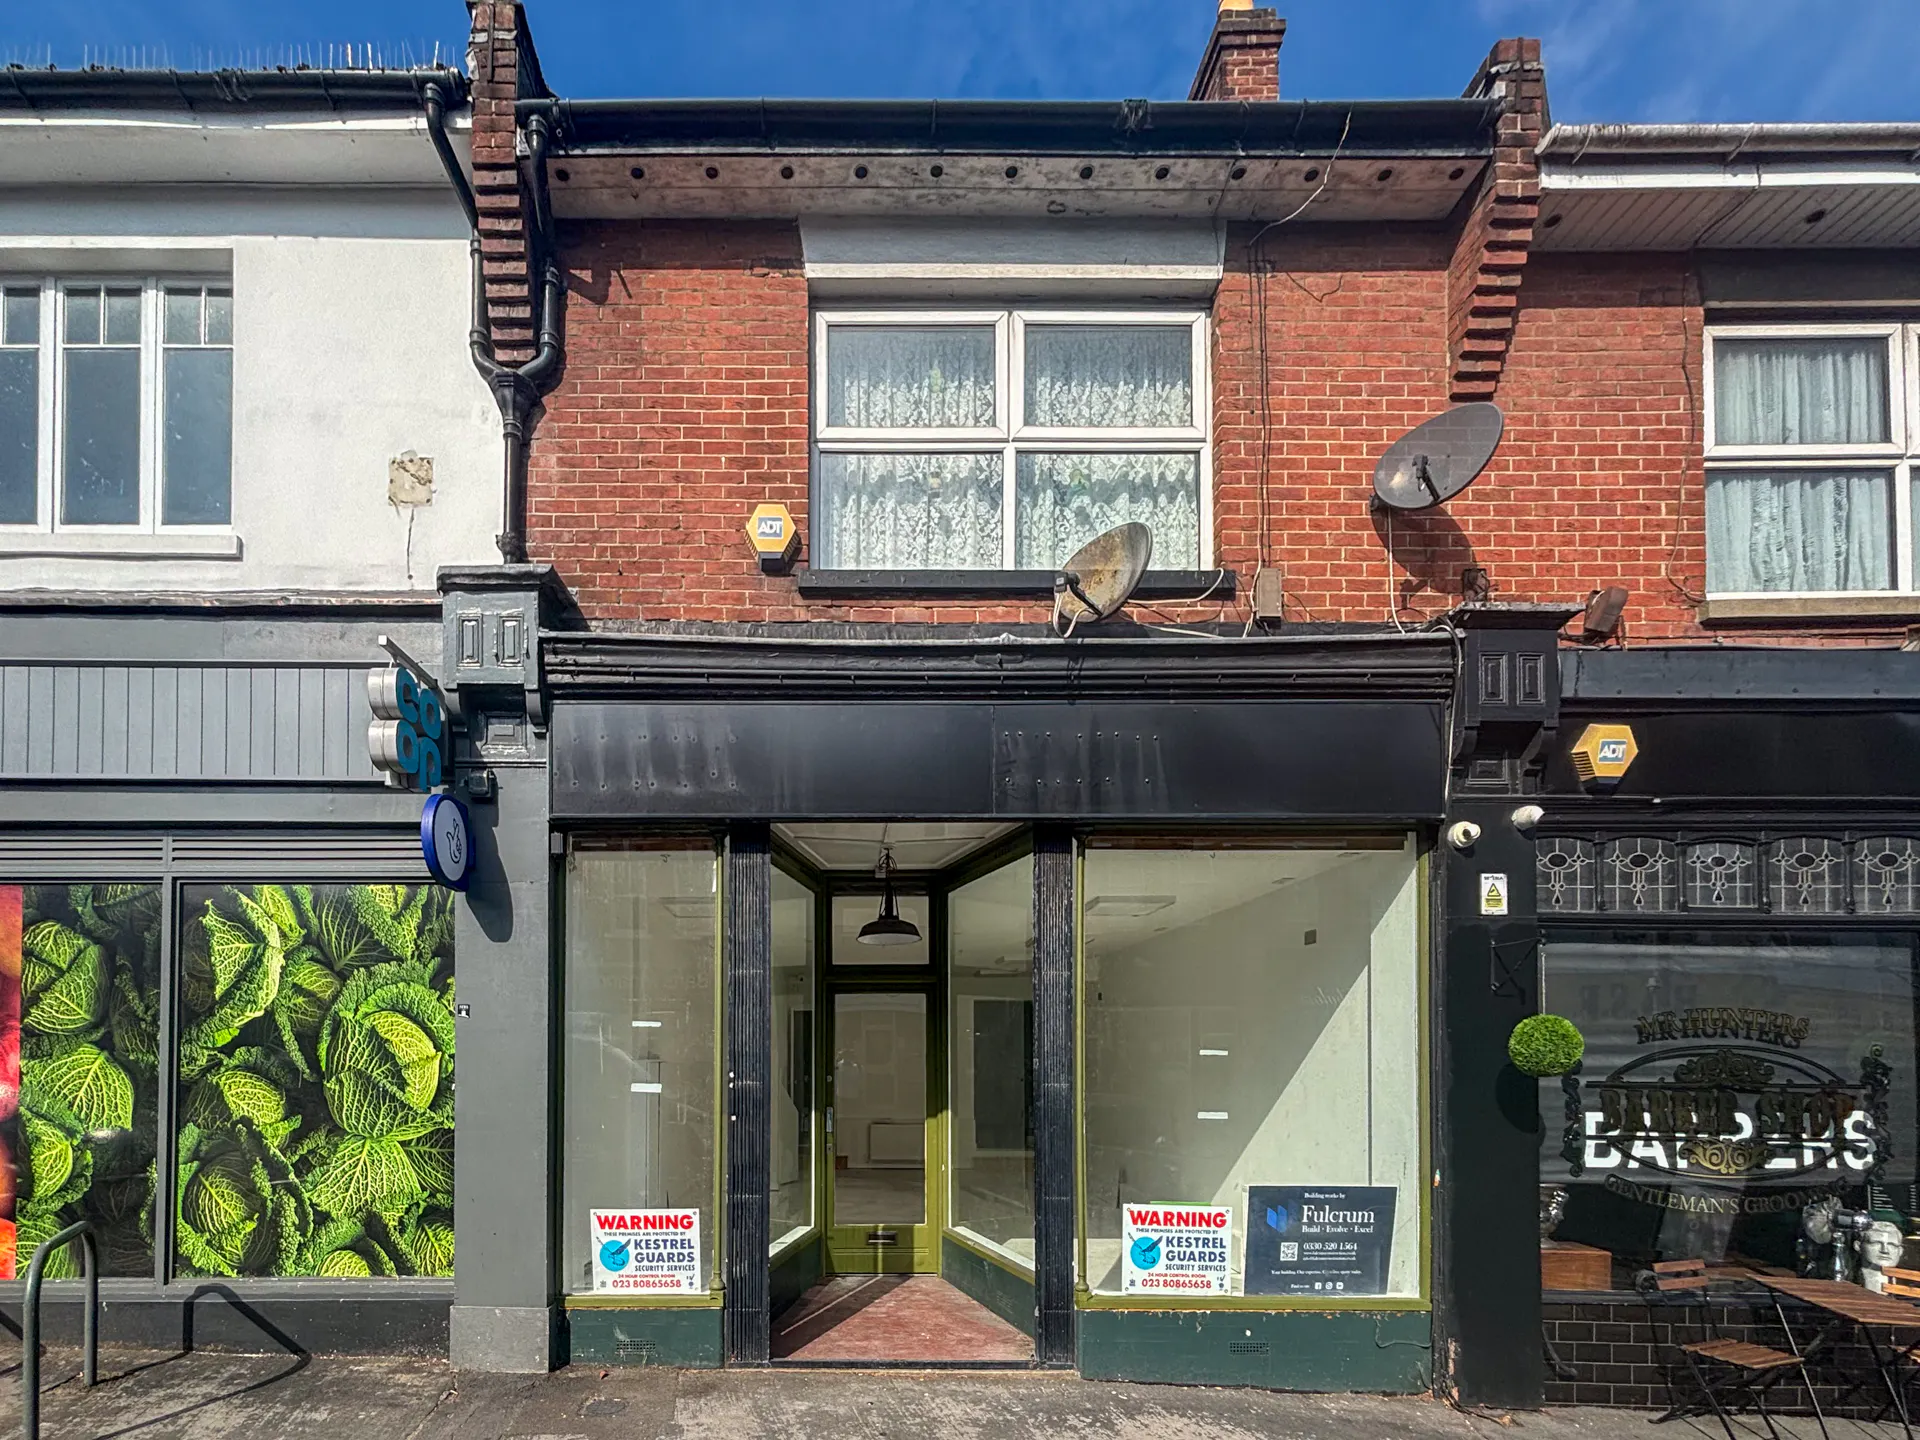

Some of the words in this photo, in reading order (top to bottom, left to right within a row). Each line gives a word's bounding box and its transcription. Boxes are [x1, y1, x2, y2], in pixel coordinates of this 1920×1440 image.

[758, 520, 783, 534] ADT
[1599, 744, 1627, 758] ADT
[1637, 1010, 1682, 1036] MR
[1683, 1007, 1811, 1040] HUNTERS
[1604, 1173, 1740, 1215] GENTLEMAN'S
[1129, 1210, 1227, 1228] WARNING
[1301, 1204, 1375, 1223] Fulcrum
[596, 1214, 694, 1230] WARNING
[1302, 1225, 1320, 1233] Build
[1326, 1225, 1348, 1233] Evolve
[1354, 1225, 1373, 1233] Excel
[634, 1239, 694, 1250] KESTREL
[1165, 1236, 1226, 1249] KESTREL
[1323, 1242, 1338, 1250] 520
[634, 1252, 695, 1263] GUARDS
[1165, 1250, 1226, 1263] GUARDS
[1198, 1264, 1226, 1272] SERVICES
[612, 1280, 631, 1288] 023
[633, 1279, 682, 1288] 80865658
[1141, 1279, 1160, 1288] 023
[1162, 1279, 1212, 1289] 80865658
